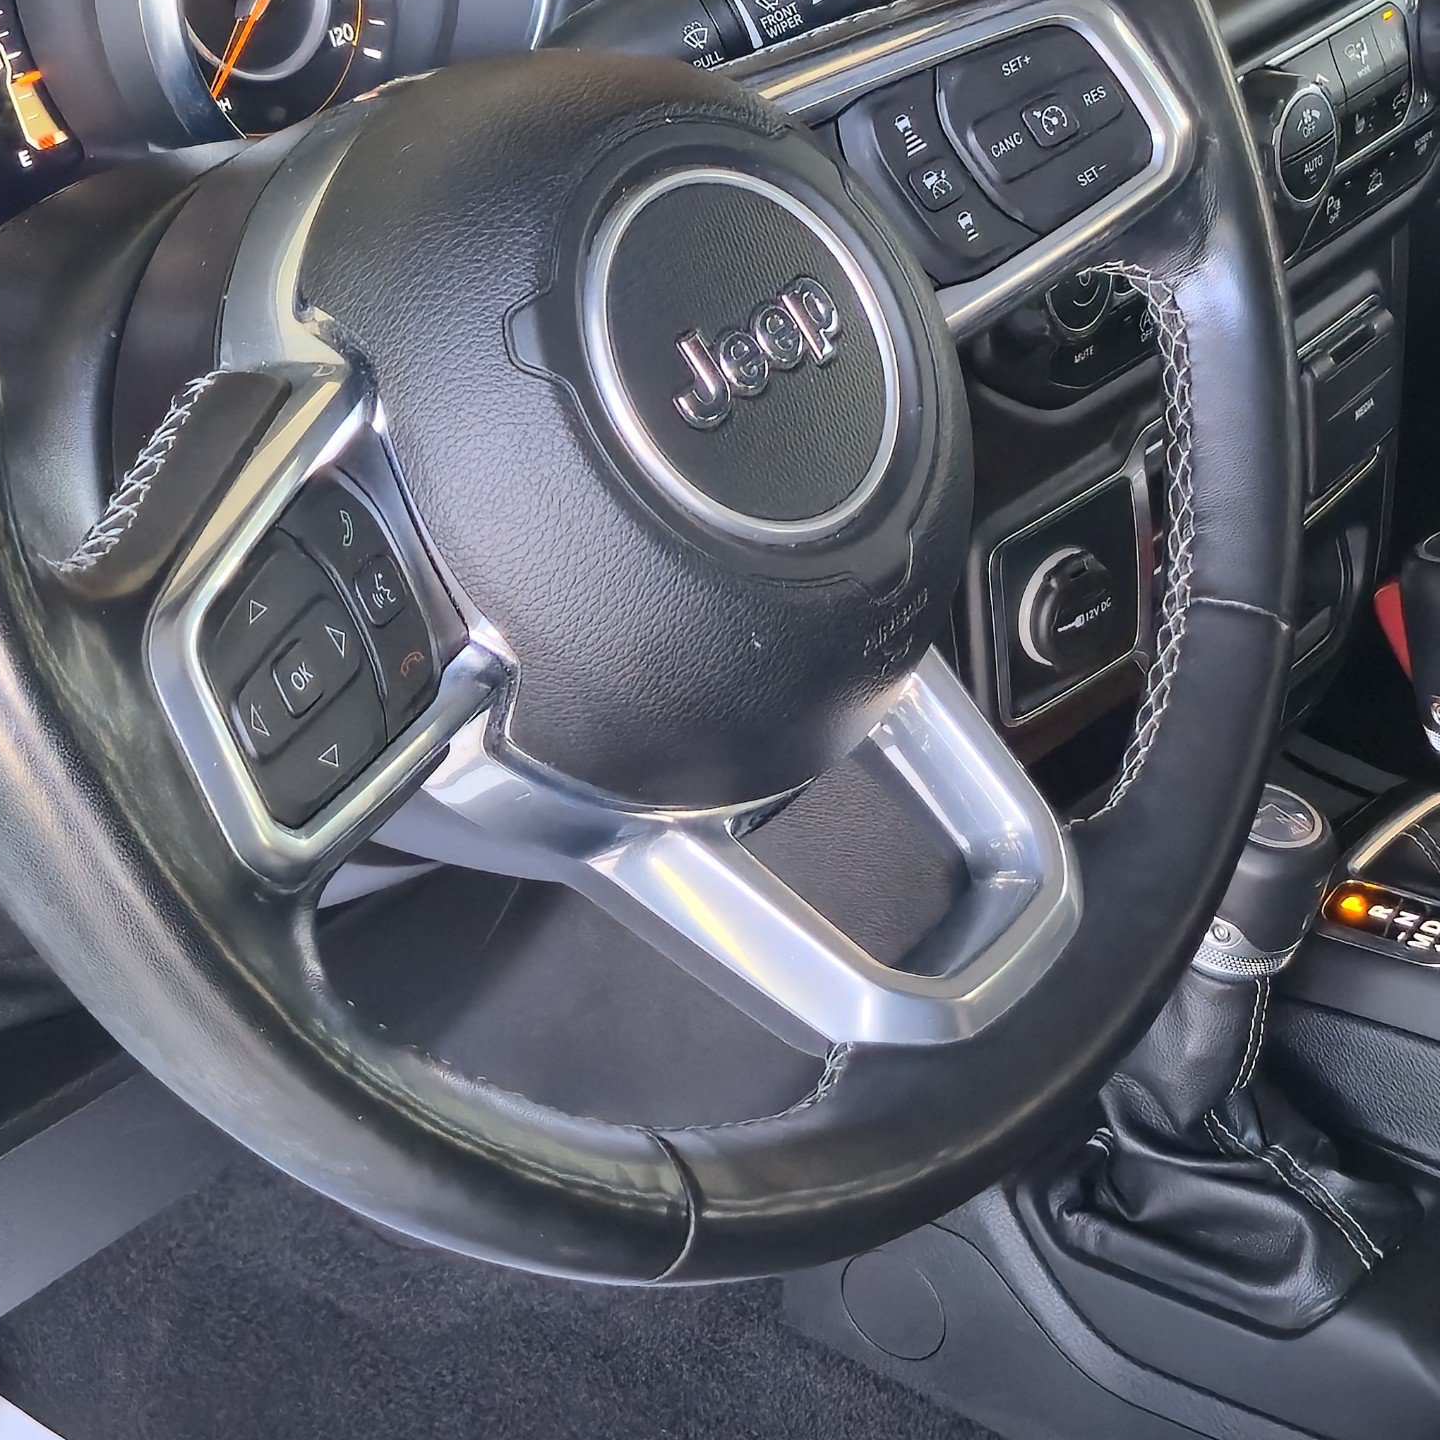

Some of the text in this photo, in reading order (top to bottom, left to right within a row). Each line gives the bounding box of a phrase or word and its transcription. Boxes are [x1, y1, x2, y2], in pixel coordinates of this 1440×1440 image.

[760, 2, 798, 30] FRONT
[764, 13, 804, 39] WIPER
[328, 22, 355, 49] 120
[693, 50, 725, 69] PULL
[1001, 54, 1032, 77] SET+
[1082, 85, 1107, 107] RES
[990, 131, 1024, 159] CANC
[18, 149, 34, 168] E
[1303, 154, 1324, 175] AUTO
[672, 277, 839, 431] Jeep
[1074, 345, 1095, 364] MUTE
[1085, 605, 1100, 621] 12V
[290, 661, 314, 692] OK
[1368, 904, 1394, 921] R
[1394, 911, 1421, 928] N
[1407, 932, 1435, 951] M
